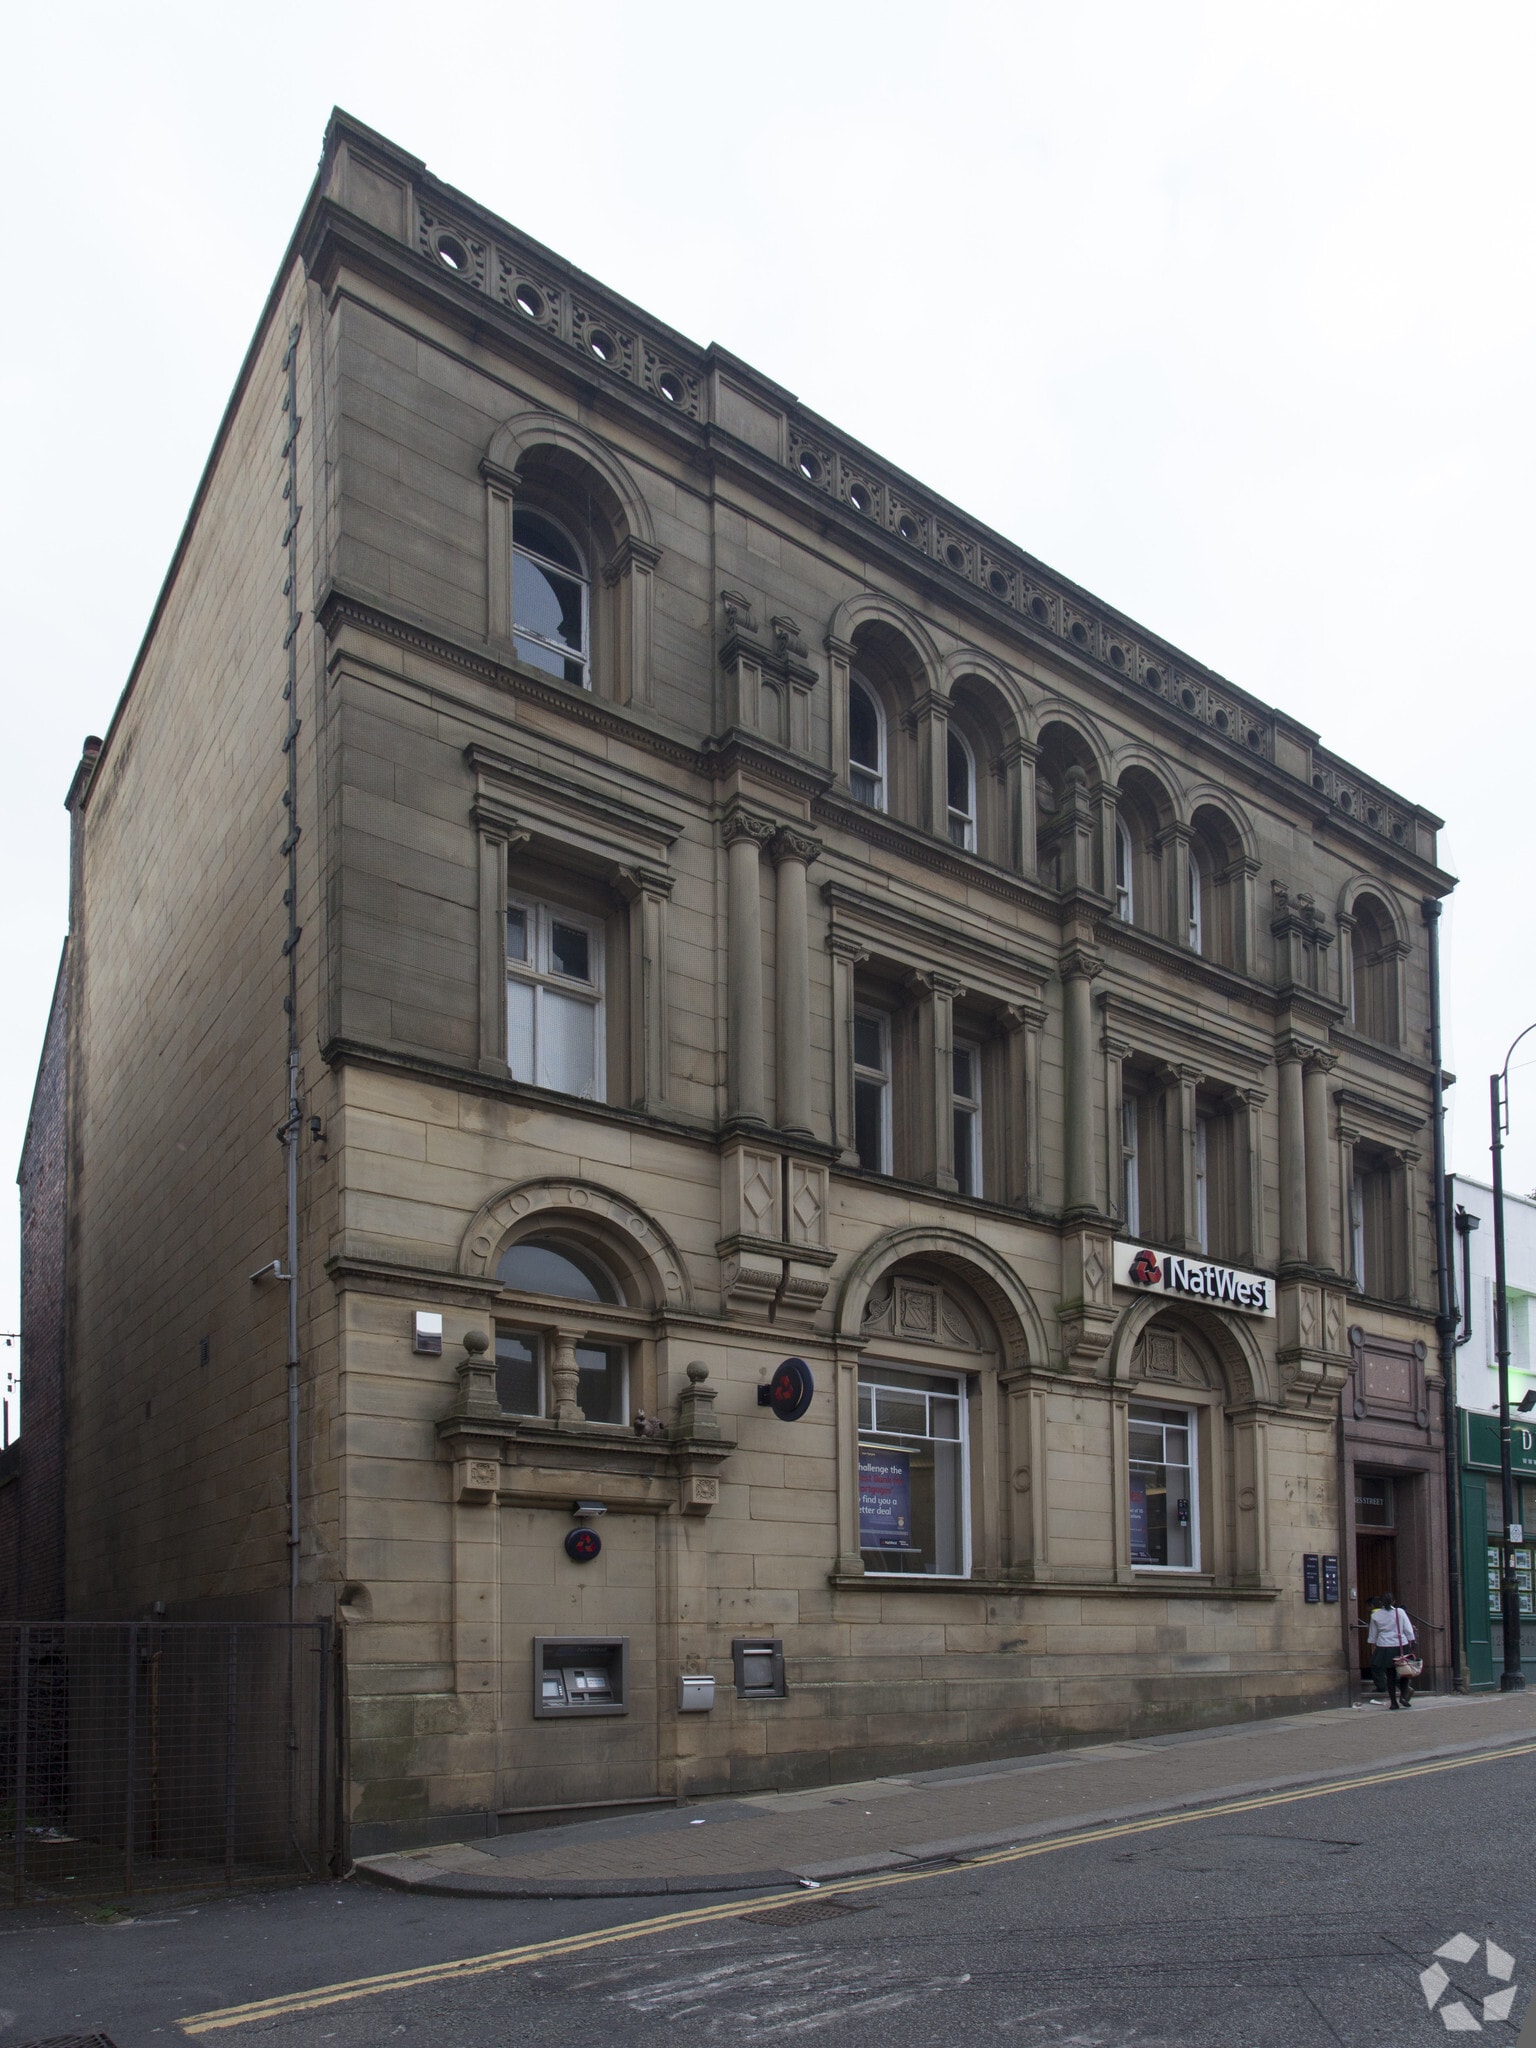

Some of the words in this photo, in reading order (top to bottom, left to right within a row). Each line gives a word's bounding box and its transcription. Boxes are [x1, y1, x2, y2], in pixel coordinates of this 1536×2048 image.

[1166, 1256, 1272, 1310] NatWest
[858, 1462, 889, 1475] hallenge
[890, 1465, 903, 1475] the
[862, 1494, 877, 1504] find
[878, 1497, 891, 1507] you
[876, 1507, 892, 1516] deal
